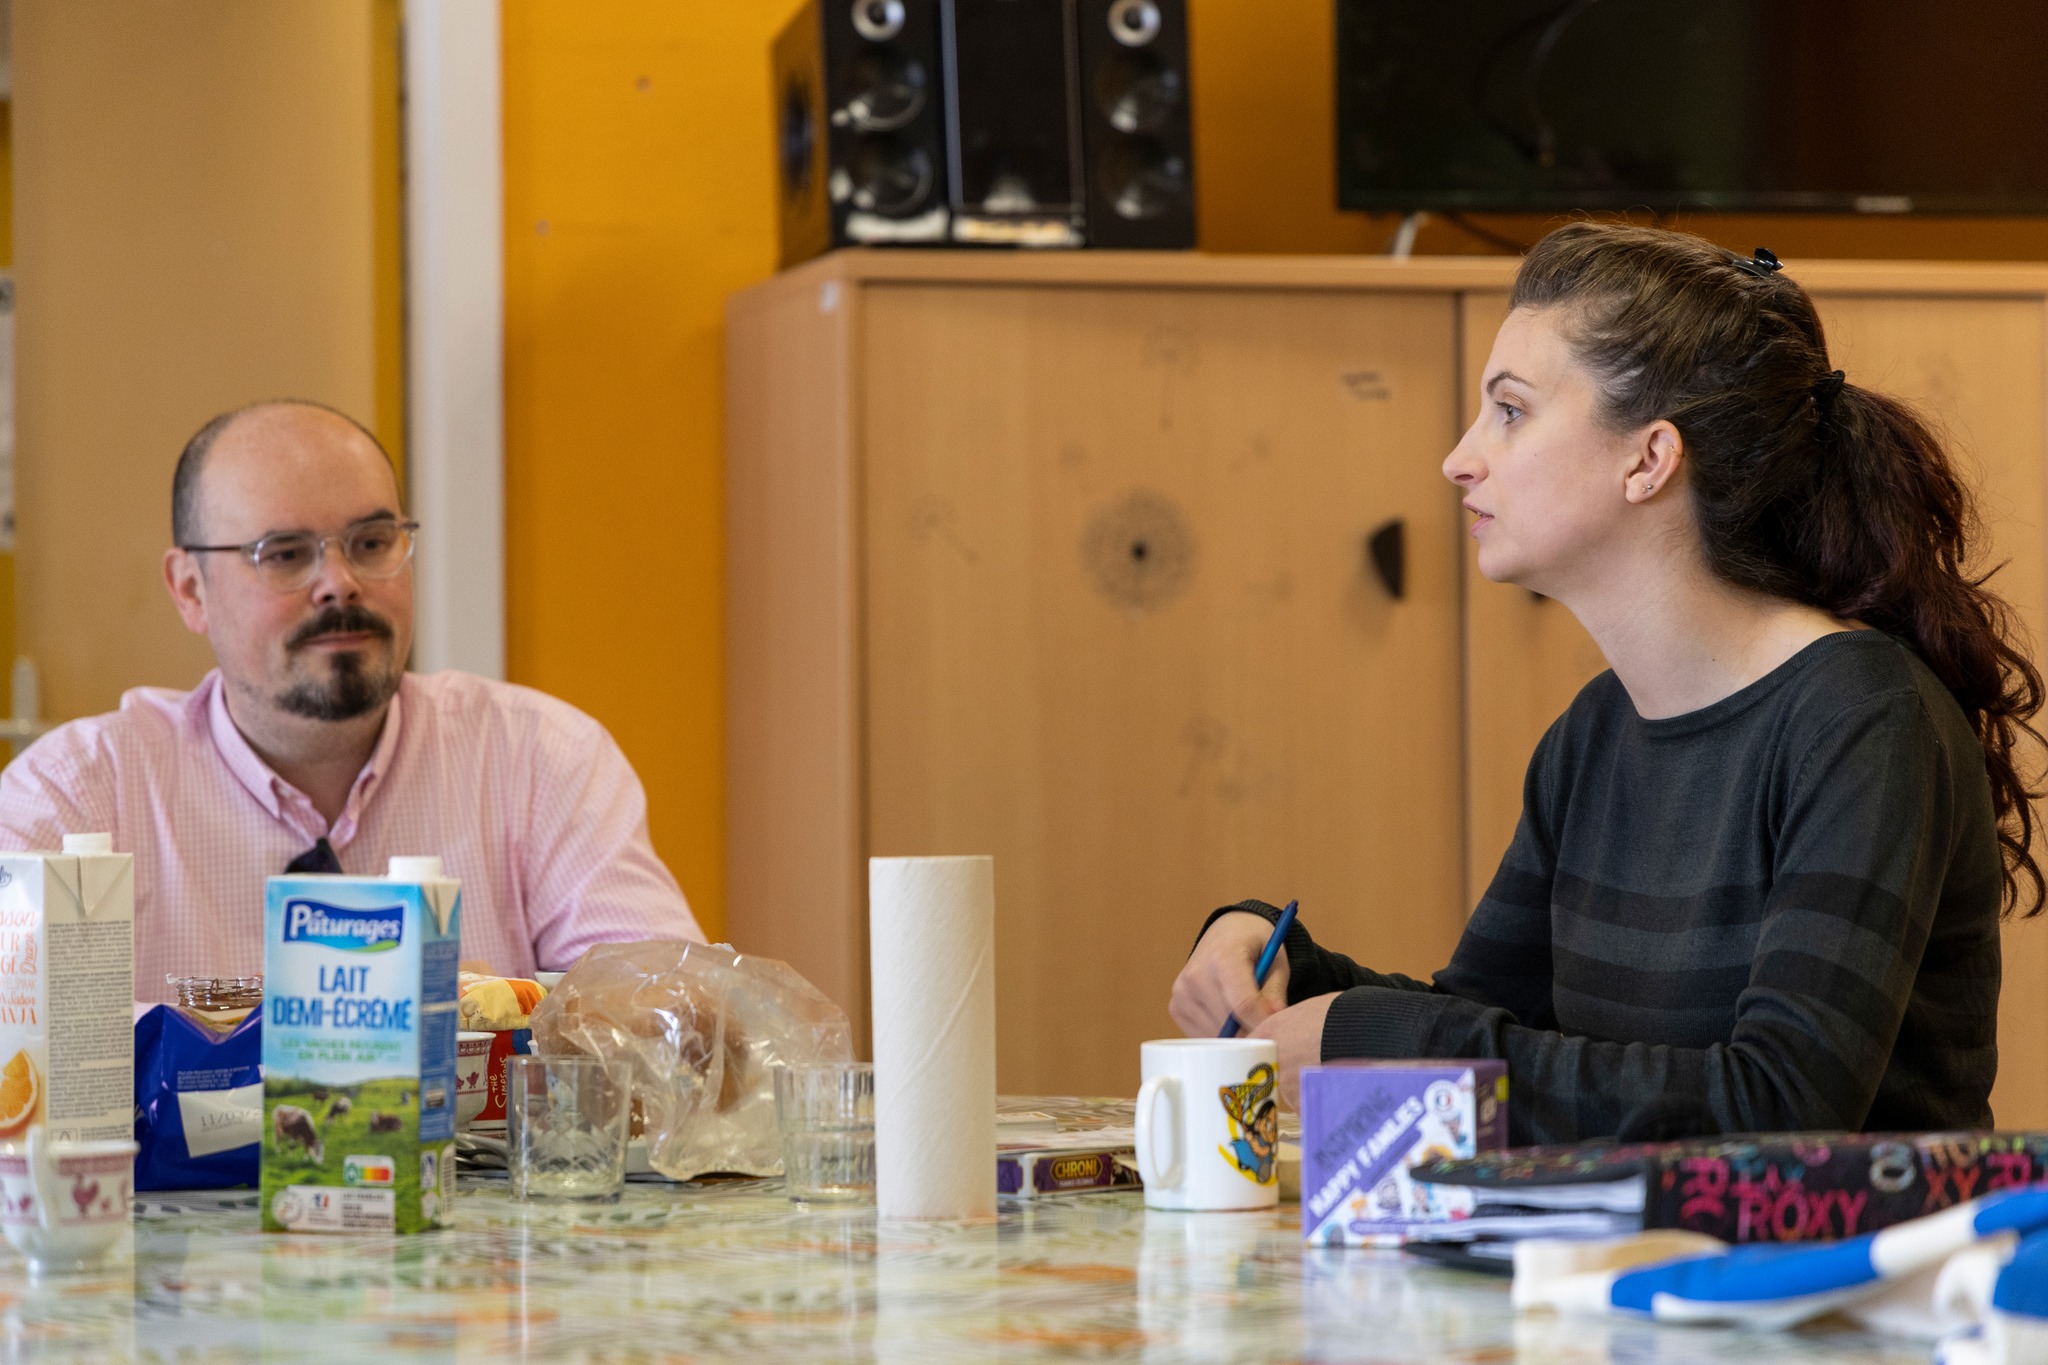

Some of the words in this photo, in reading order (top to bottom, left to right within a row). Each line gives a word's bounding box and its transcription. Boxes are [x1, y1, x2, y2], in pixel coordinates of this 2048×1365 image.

[290, 904, 401, 944] Pâturages
[319, 964, 370, 993] LAIT
[272, 994, 412, 1032] DEMI-ÉCRÉMÉ
[1055, 1158, 1097, 1178] CHRONI
[1309, 1158, 1362, 1218] HAPPY
[1356, 1095, 1426, 1168] FAMILIES
[1738, 1182, 1868, 1242] ROXY
